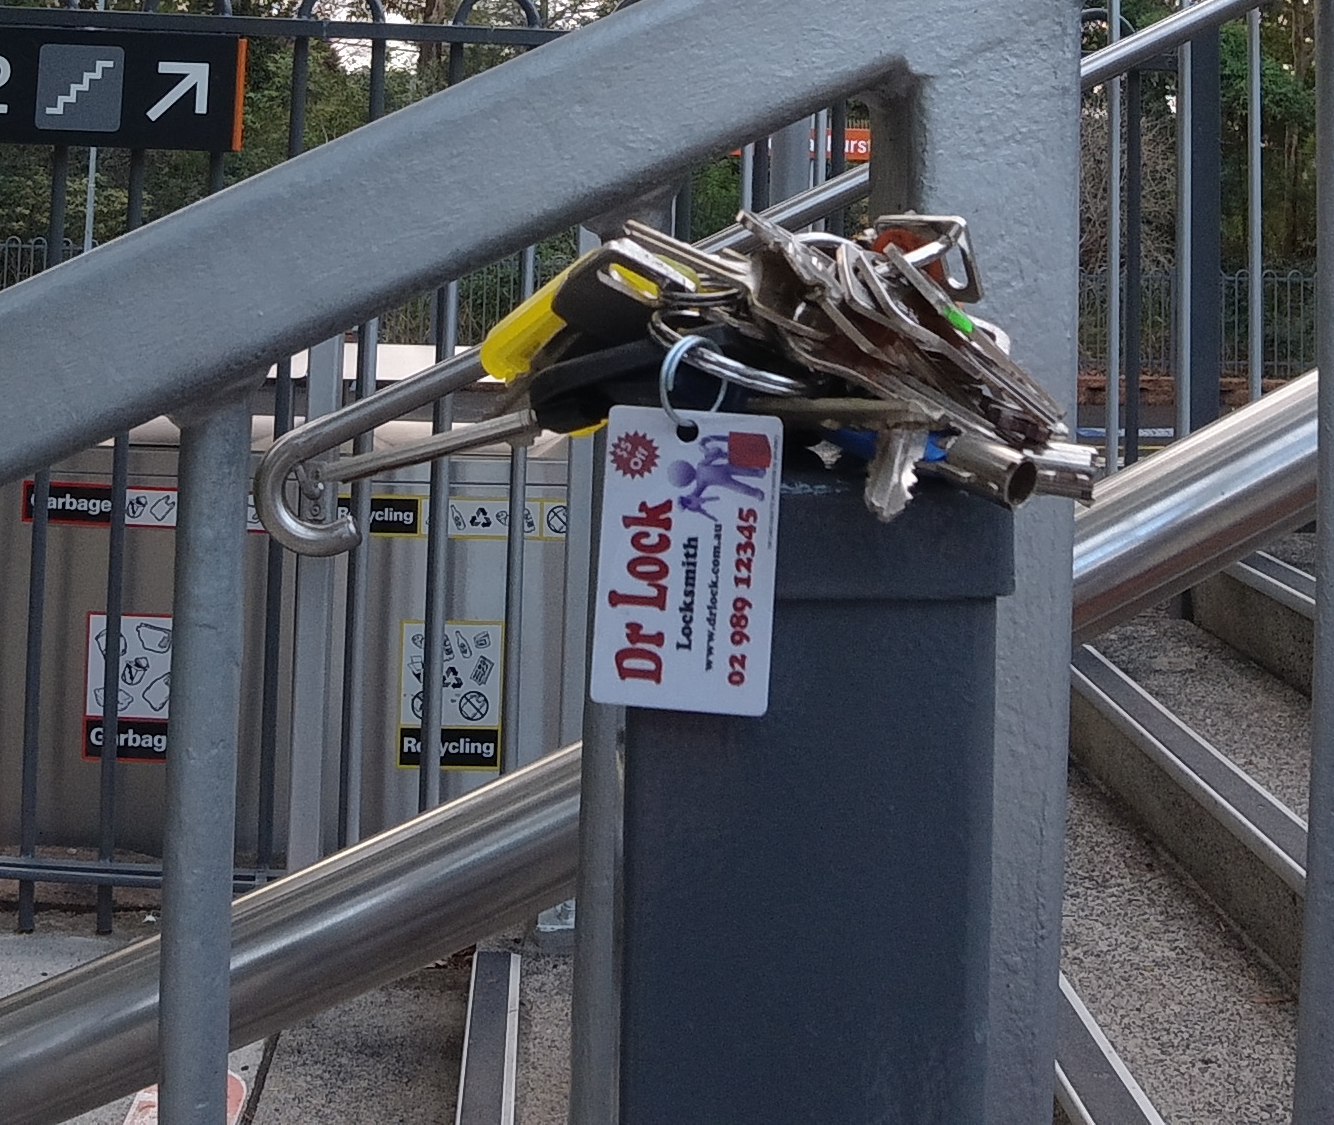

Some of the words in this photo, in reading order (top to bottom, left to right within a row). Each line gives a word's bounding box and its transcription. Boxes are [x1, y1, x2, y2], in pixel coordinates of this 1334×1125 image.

[616, 440, 632, 458] $5
[629, 446, 649, 470] Off
[338, 507, 414, 525] Rycling
[608, 498, 674, 612] Lock
[733, 507, 759, 590] 12345
[676, 535, 699, 652] Locksmith
[705, 523, 723, 672] www.drlock.com.au
[730, 596, 753, 647] 989
[615, 621, 666, 686] Dr
[728, 653, 747, 687] 02
[90, 727, 167, 752] Grbag
[404, 737, 495, 758] Rycling
